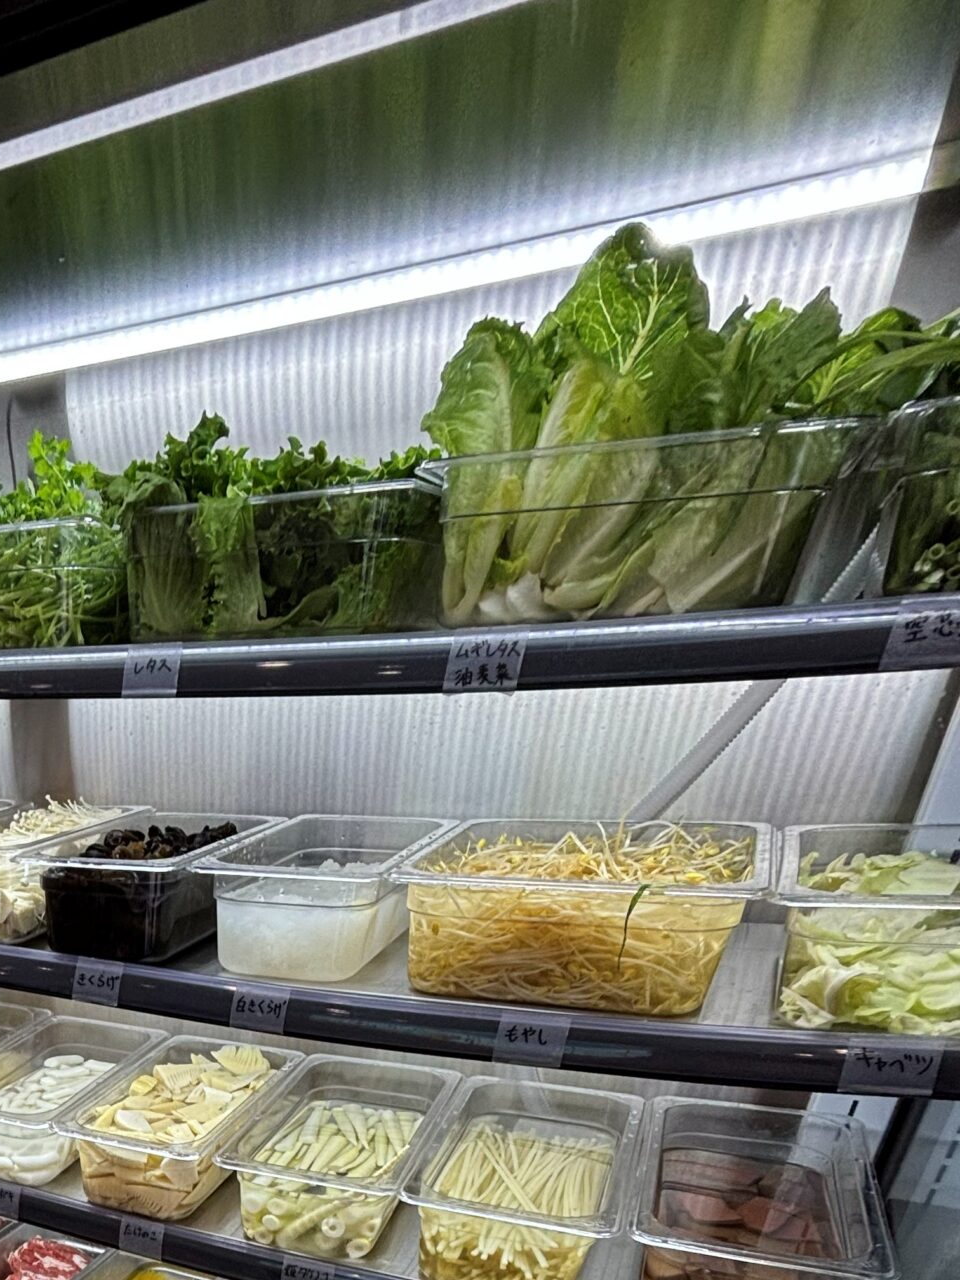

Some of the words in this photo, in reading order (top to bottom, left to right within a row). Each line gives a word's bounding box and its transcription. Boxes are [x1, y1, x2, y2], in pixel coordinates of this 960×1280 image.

[134, 658, 172, 675] レタス
[77, 972, 120, 990] きくらげ
[235, 996, 287, 1019] 白きくらげ
[505, 1025, 548, 1046] もやし
[855, 1047, 934, 1076] キャベツ
